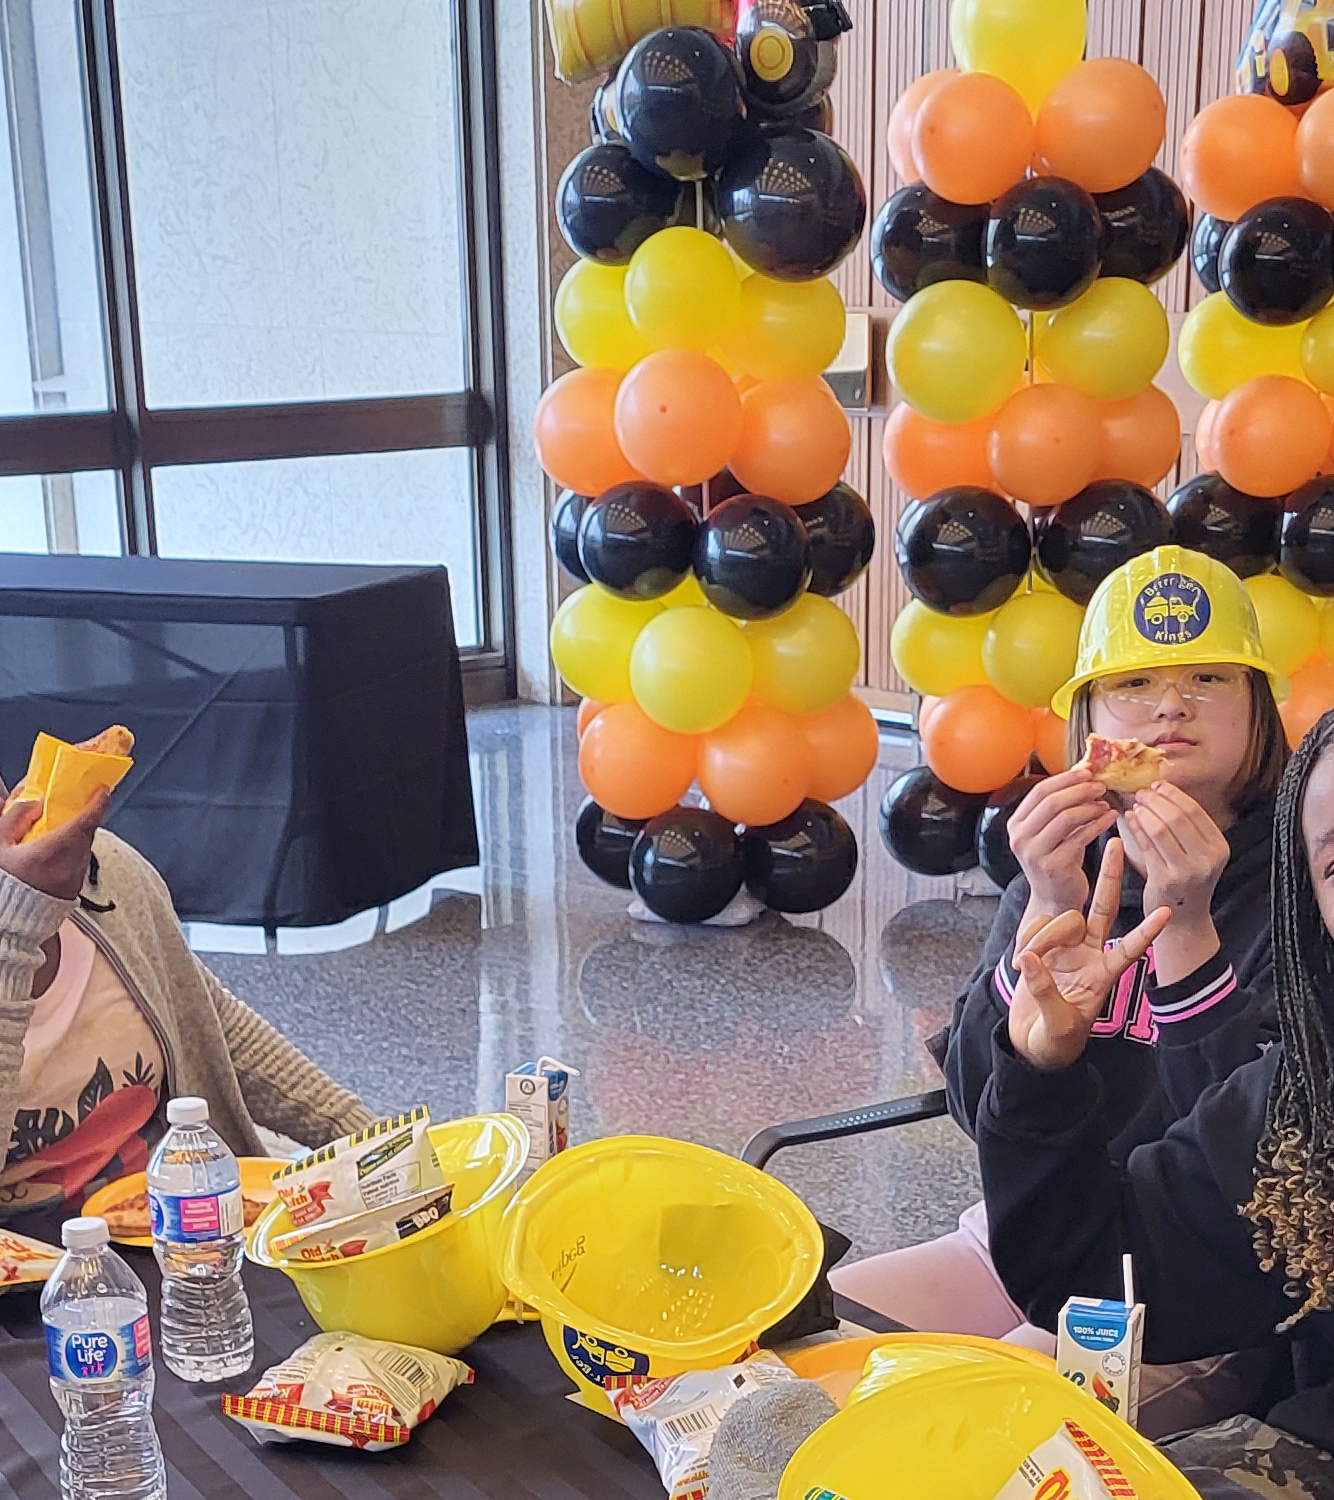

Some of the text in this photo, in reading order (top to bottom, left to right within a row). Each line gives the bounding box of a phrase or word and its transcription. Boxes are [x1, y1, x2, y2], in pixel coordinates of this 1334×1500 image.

[413, 1206, 439, 1229] BBQ
[300, 1245, 322, 1259] Old
[1073, 1326, 1119, 1338] 100% JUICE
[71, 1335, 108, 1348] Pure
[77, 1349, 105, 1365] Life
